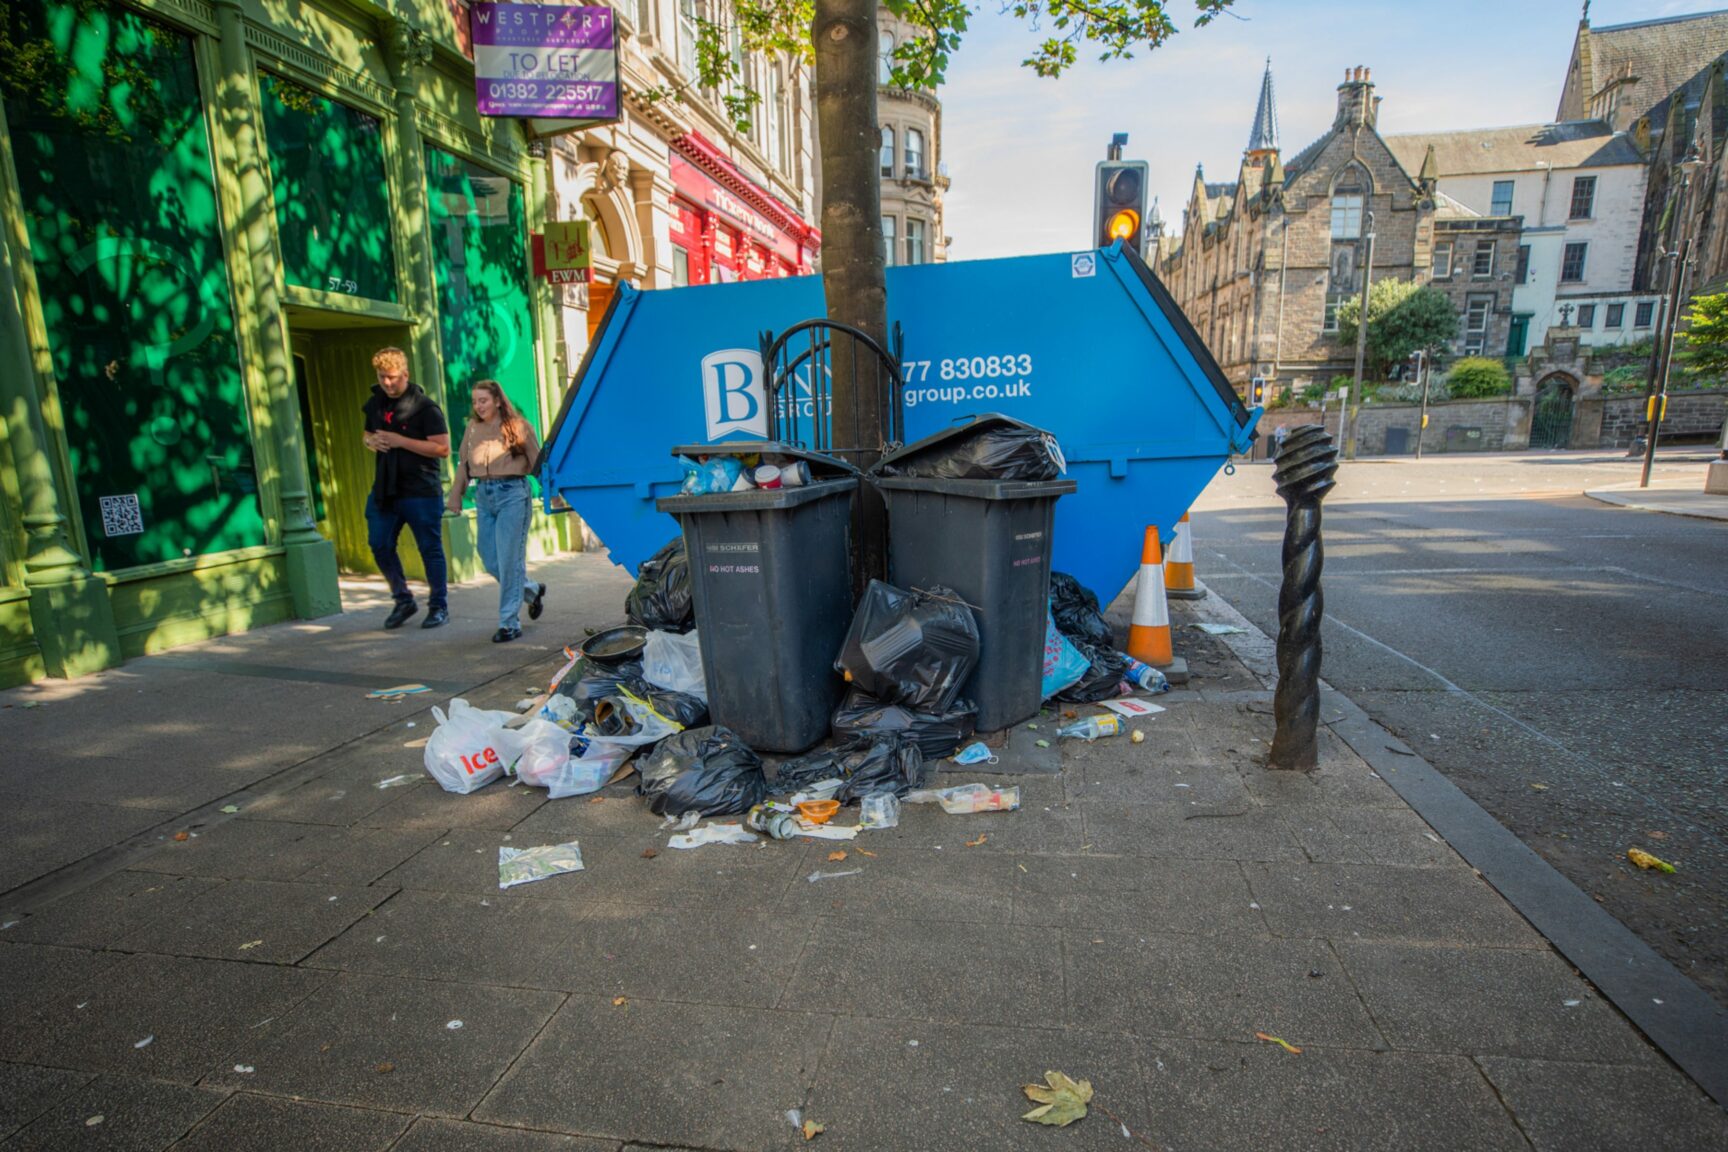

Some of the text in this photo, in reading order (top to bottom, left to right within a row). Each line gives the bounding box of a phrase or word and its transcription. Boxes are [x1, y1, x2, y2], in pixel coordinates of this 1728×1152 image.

[508, 53, 580, 72] TO LET
[489, 83, 603, 101] 01382 225517
[328, 276, 358, 294] 57-59
[551, 269, 586, 283] EWM
[902, 354, 1033, 382] 77 830833
[905, 380, 1032, 407] group.co.uk
[720, 565, 734, 573] HOT
[736, 565, 759, 573] ASHES
[460, 746, 500, 775] Ice
